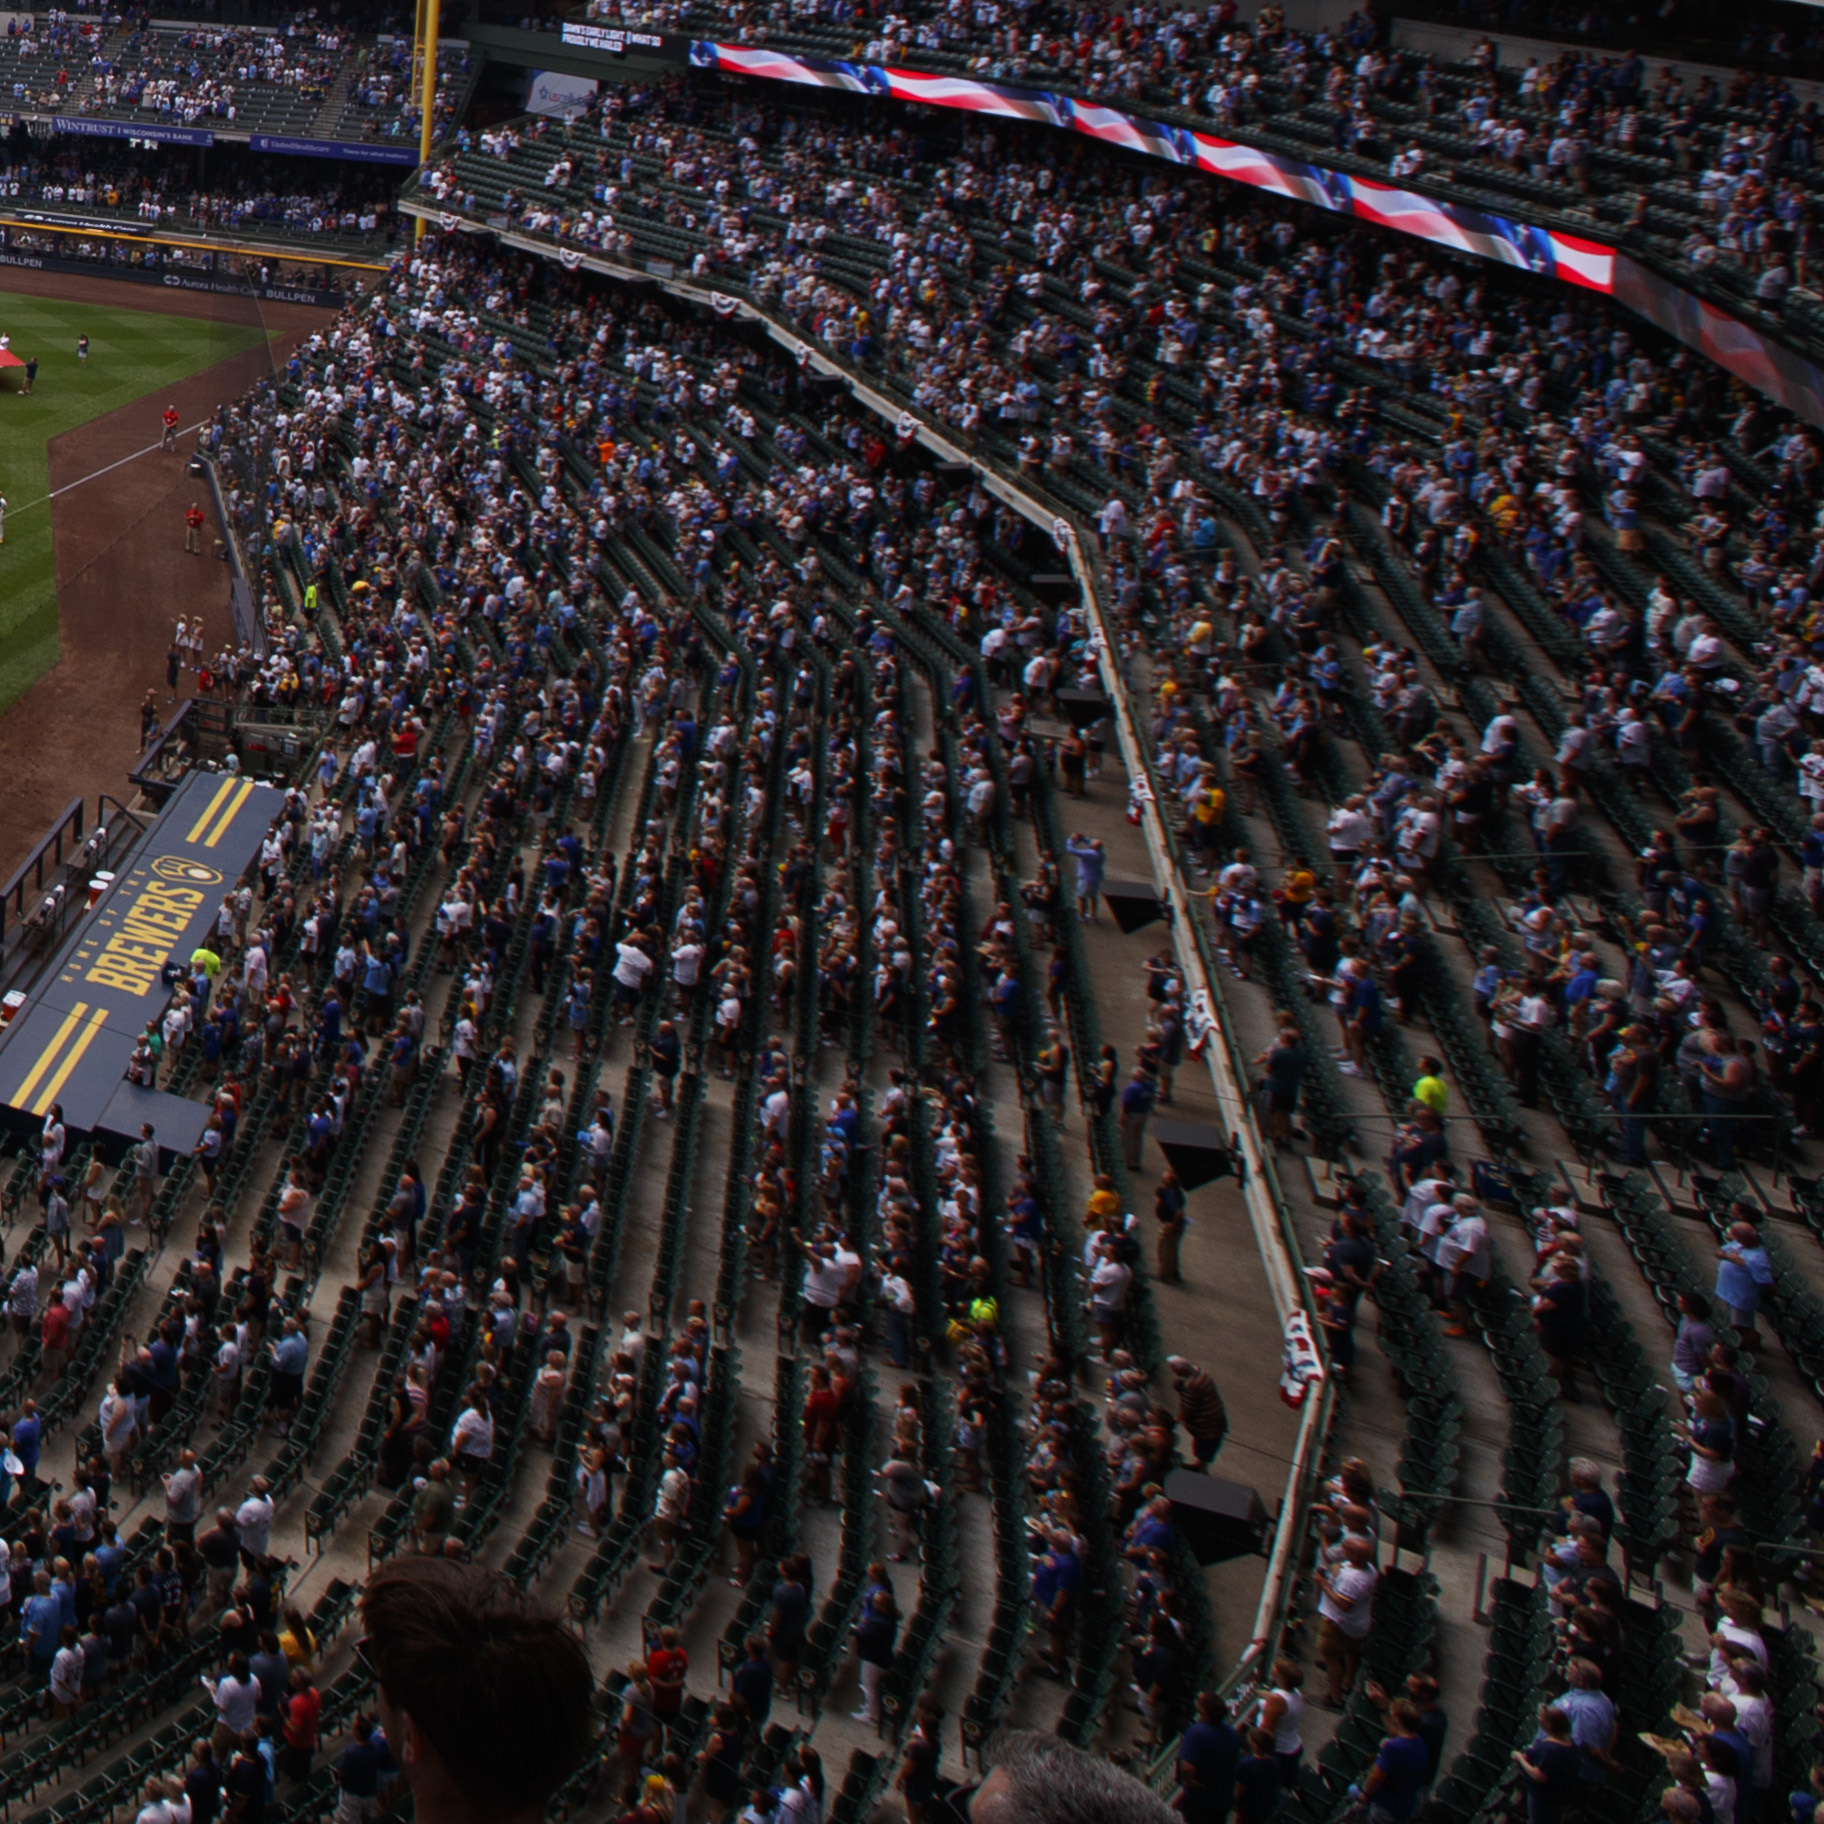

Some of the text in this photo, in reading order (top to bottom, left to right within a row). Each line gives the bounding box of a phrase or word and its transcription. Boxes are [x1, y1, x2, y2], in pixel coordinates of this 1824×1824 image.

[55, 118, 116, 134] WINTRUST
[122, 128, 194, 142] WISCONSIN'S BANK
[271, 140, 331, 153] UnitedHealthcare
[0, 254, 42, 268] BULLPEN
[266, 288, 315, 303] BULLPEN
[85, 880, 205, 997] BREWERS
